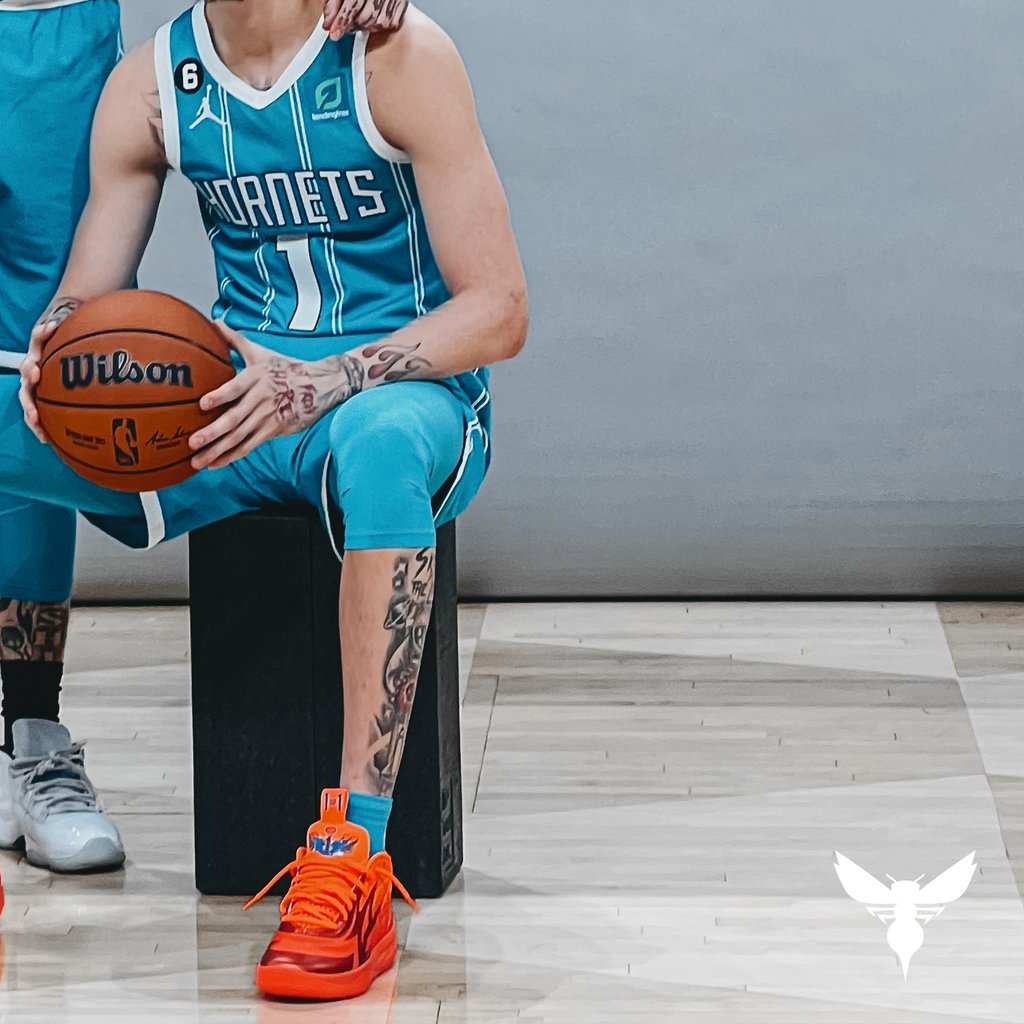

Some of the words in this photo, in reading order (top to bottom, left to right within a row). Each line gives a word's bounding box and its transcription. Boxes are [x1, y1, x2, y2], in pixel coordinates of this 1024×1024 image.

[181, 63, 199, 90] 6
[276, 233, 323, 332] 1
[59, 347, 194, 390] Wilson
